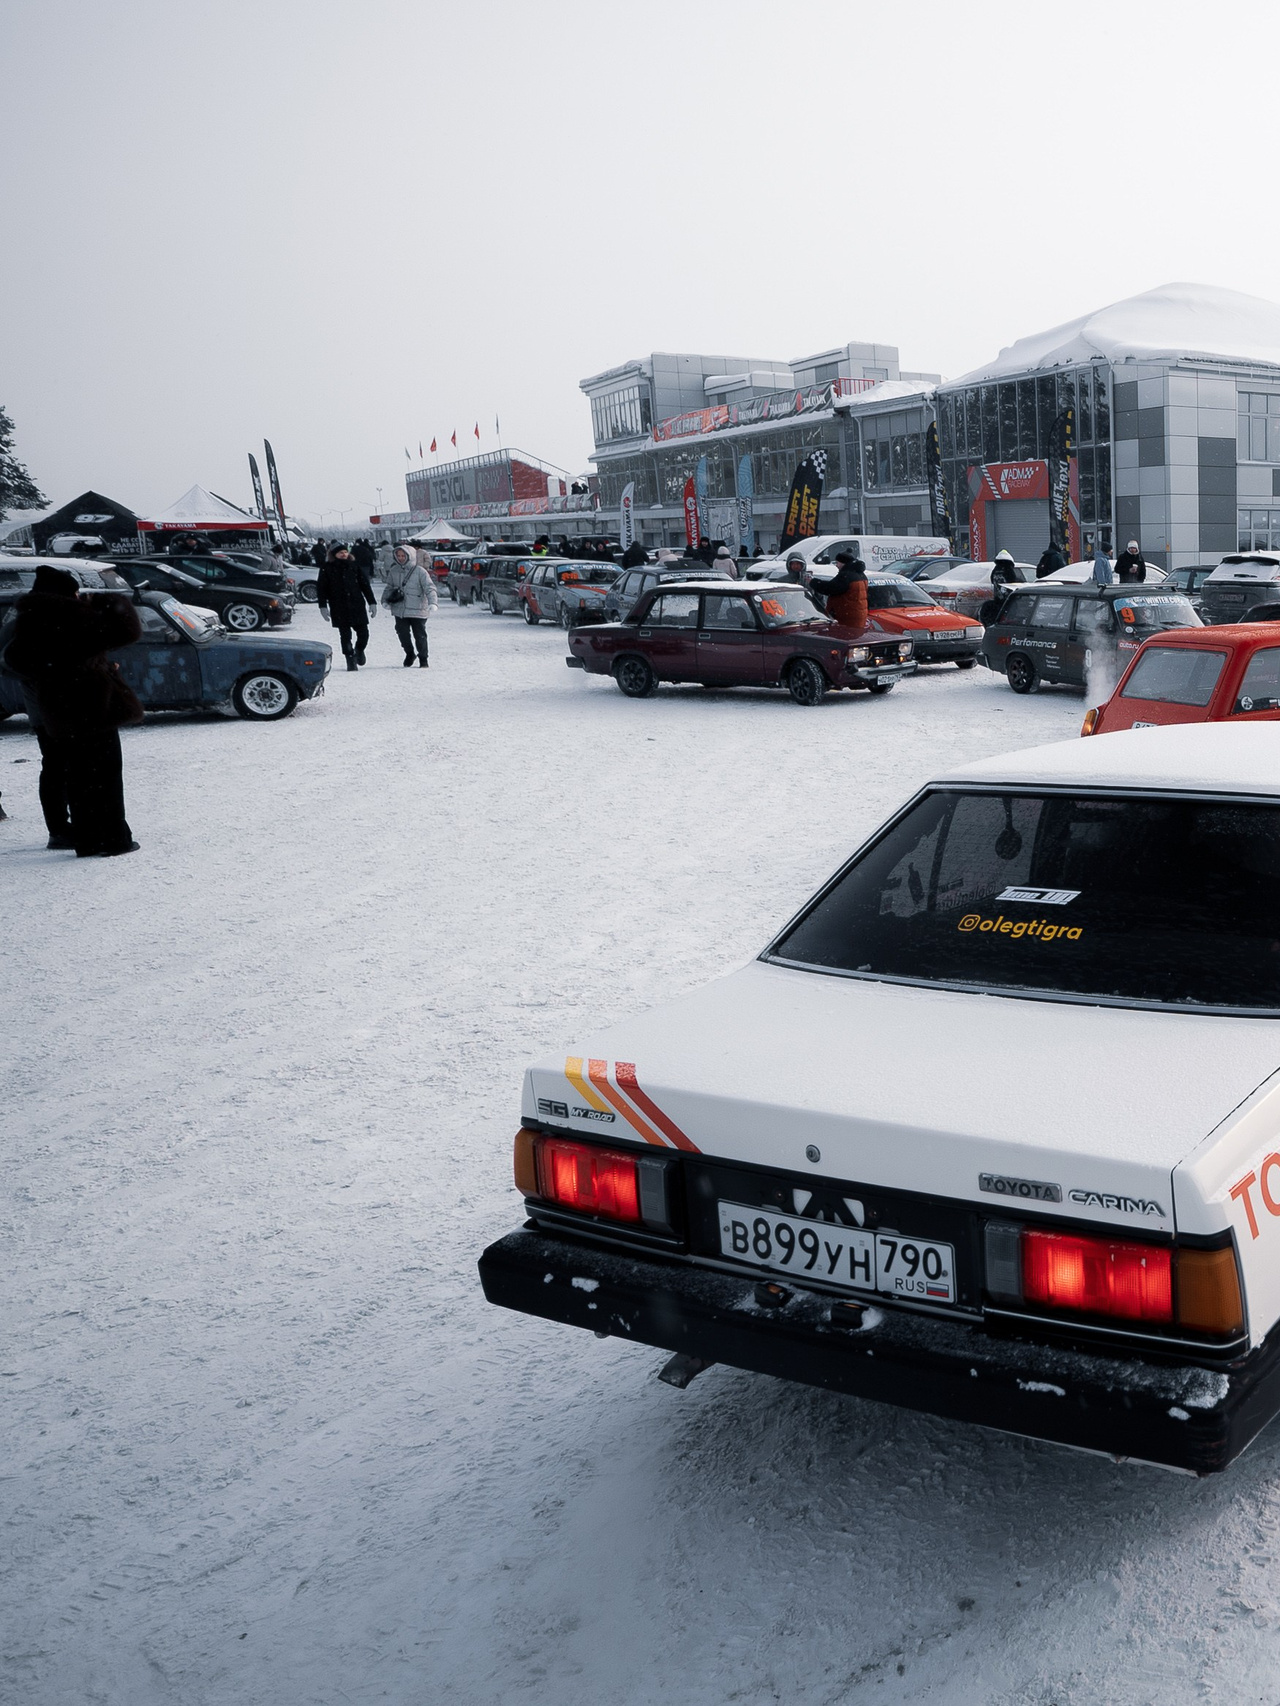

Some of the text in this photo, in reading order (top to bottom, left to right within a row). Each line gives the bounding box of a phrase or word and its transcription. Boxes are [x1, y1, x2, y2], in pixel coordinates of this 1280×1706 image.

[1008, 469, 1025, 480] ADM
[1059, 460, 1068, 489] TAXI
[432, 475, 471, 505] TEXOL
[934, 483, 946, 516] DRIFT
[786, 489, 801, 536] DRIFT
[799, 484, 811, 535] DRIFT
[806, 497, 818, 536] TAXI
[625, 509, 633, 549] TAKAYAMA
[691, 511, 700, 549] AKAYAMA
[878, 546, 898, 554] АВТО
[761, 599, 785, 617] 45
[1121, 607, 1136, 623] 9
[1145, 596, 1170, 605] WINTER
[538, 1099, 567, 1118] SG
[571, 1107, 614, 1122] MY ROAD
[984, 1177, 1055, 1200] TOYOTA
[1068, 1189, 1166, 1218] CARINA
[880, 1238, 944, 1280] 790
[894, 1277, 926, 1294] RUS
